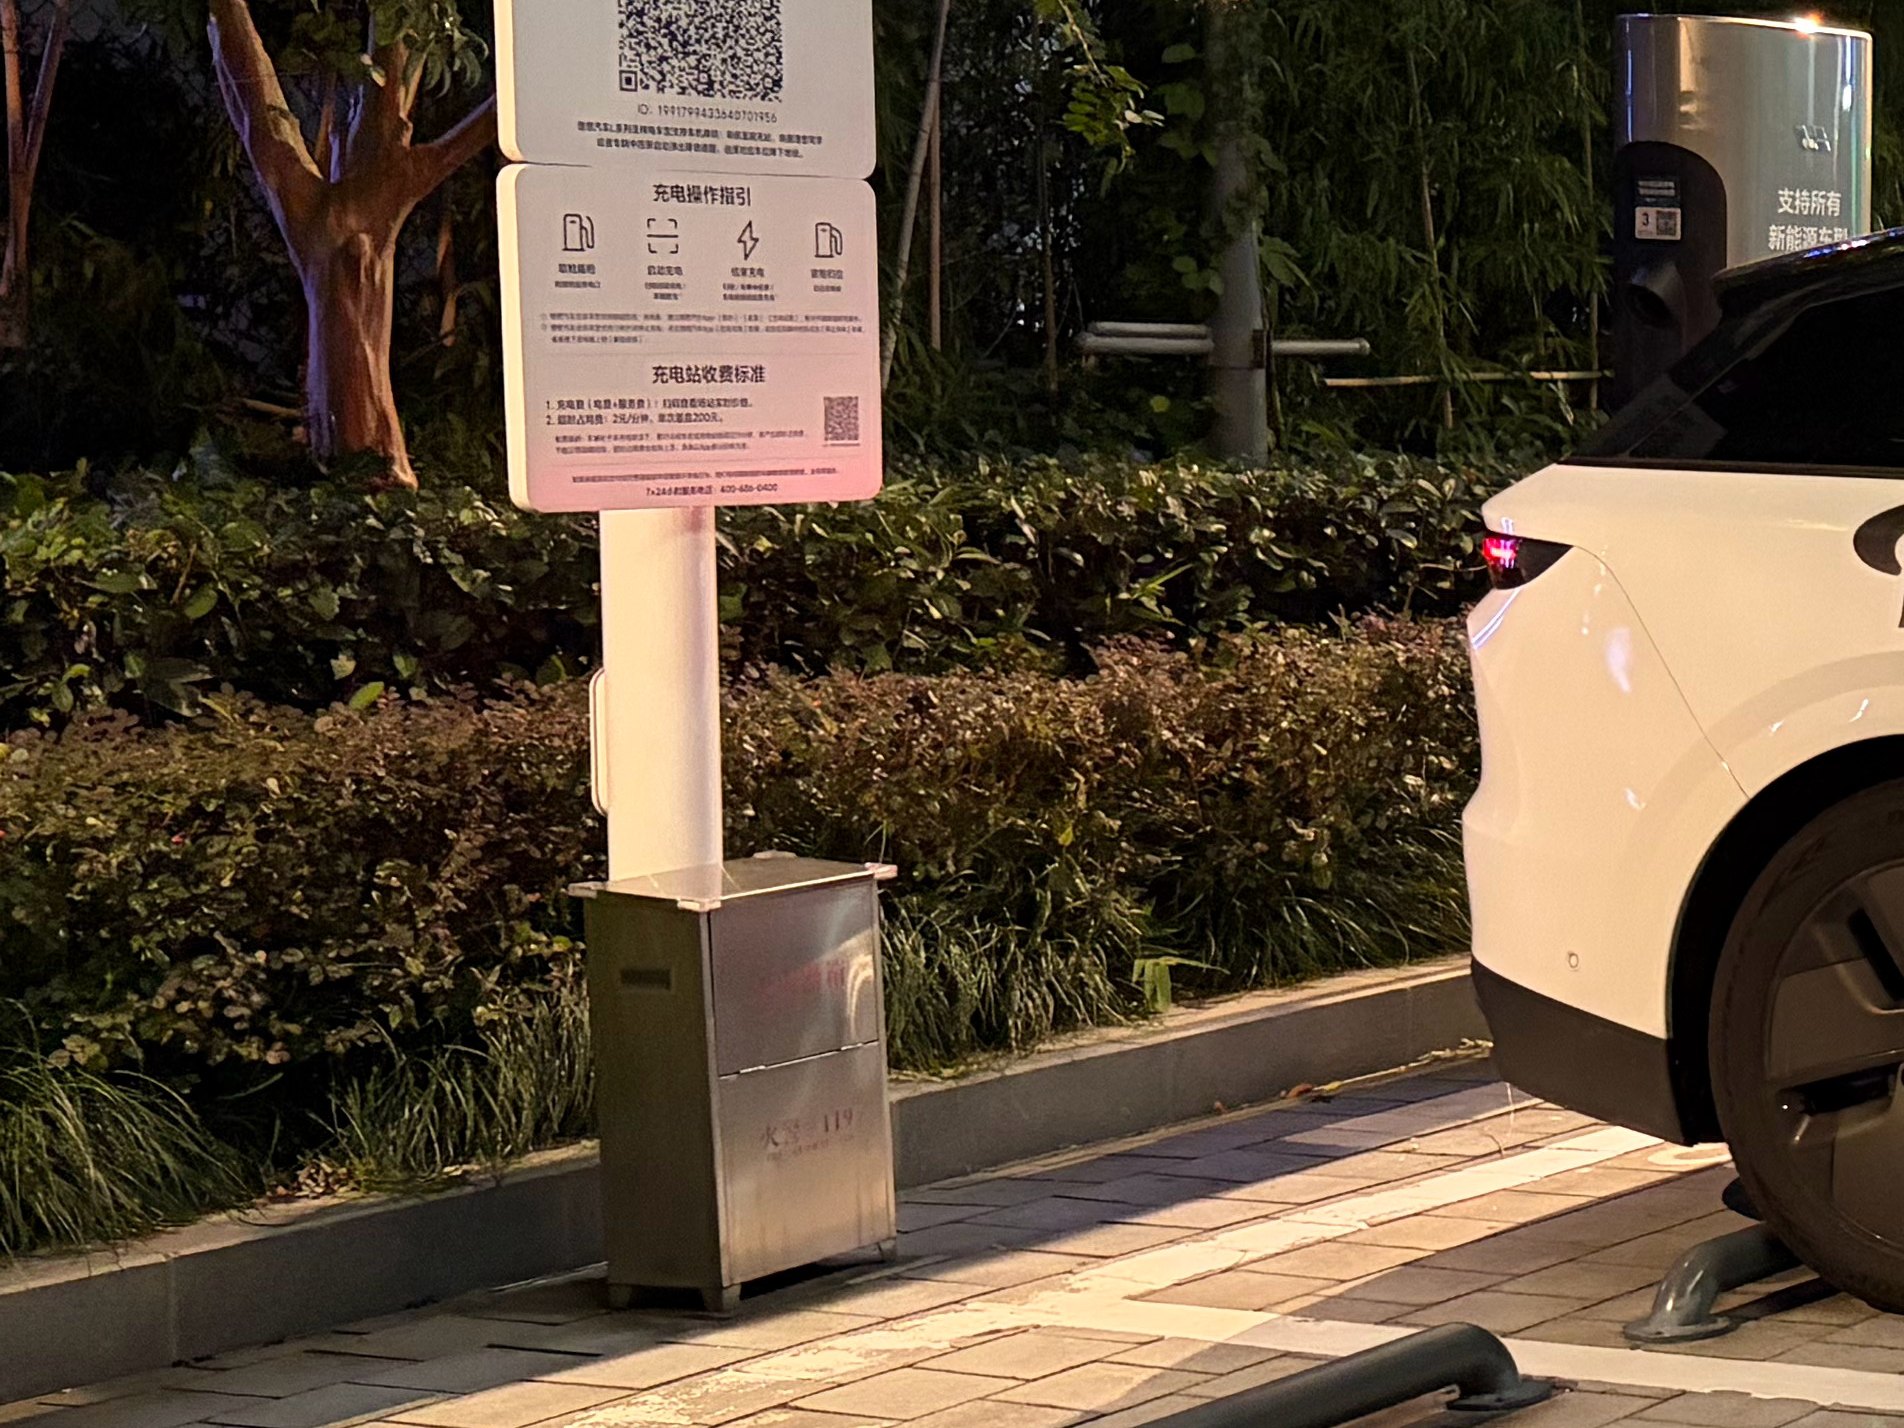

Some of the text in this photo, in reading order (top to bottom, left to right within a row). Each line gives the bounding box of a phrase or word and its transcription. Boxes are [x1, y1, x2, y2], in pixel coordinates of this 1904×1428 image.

[653, 184, 752, 206] 充电操作指引
[1777, 188, 1841, 216] 支持所有
[1641, 212, 1651, 227] 3
[652, 365, 766, 384] 充电站收费标准
